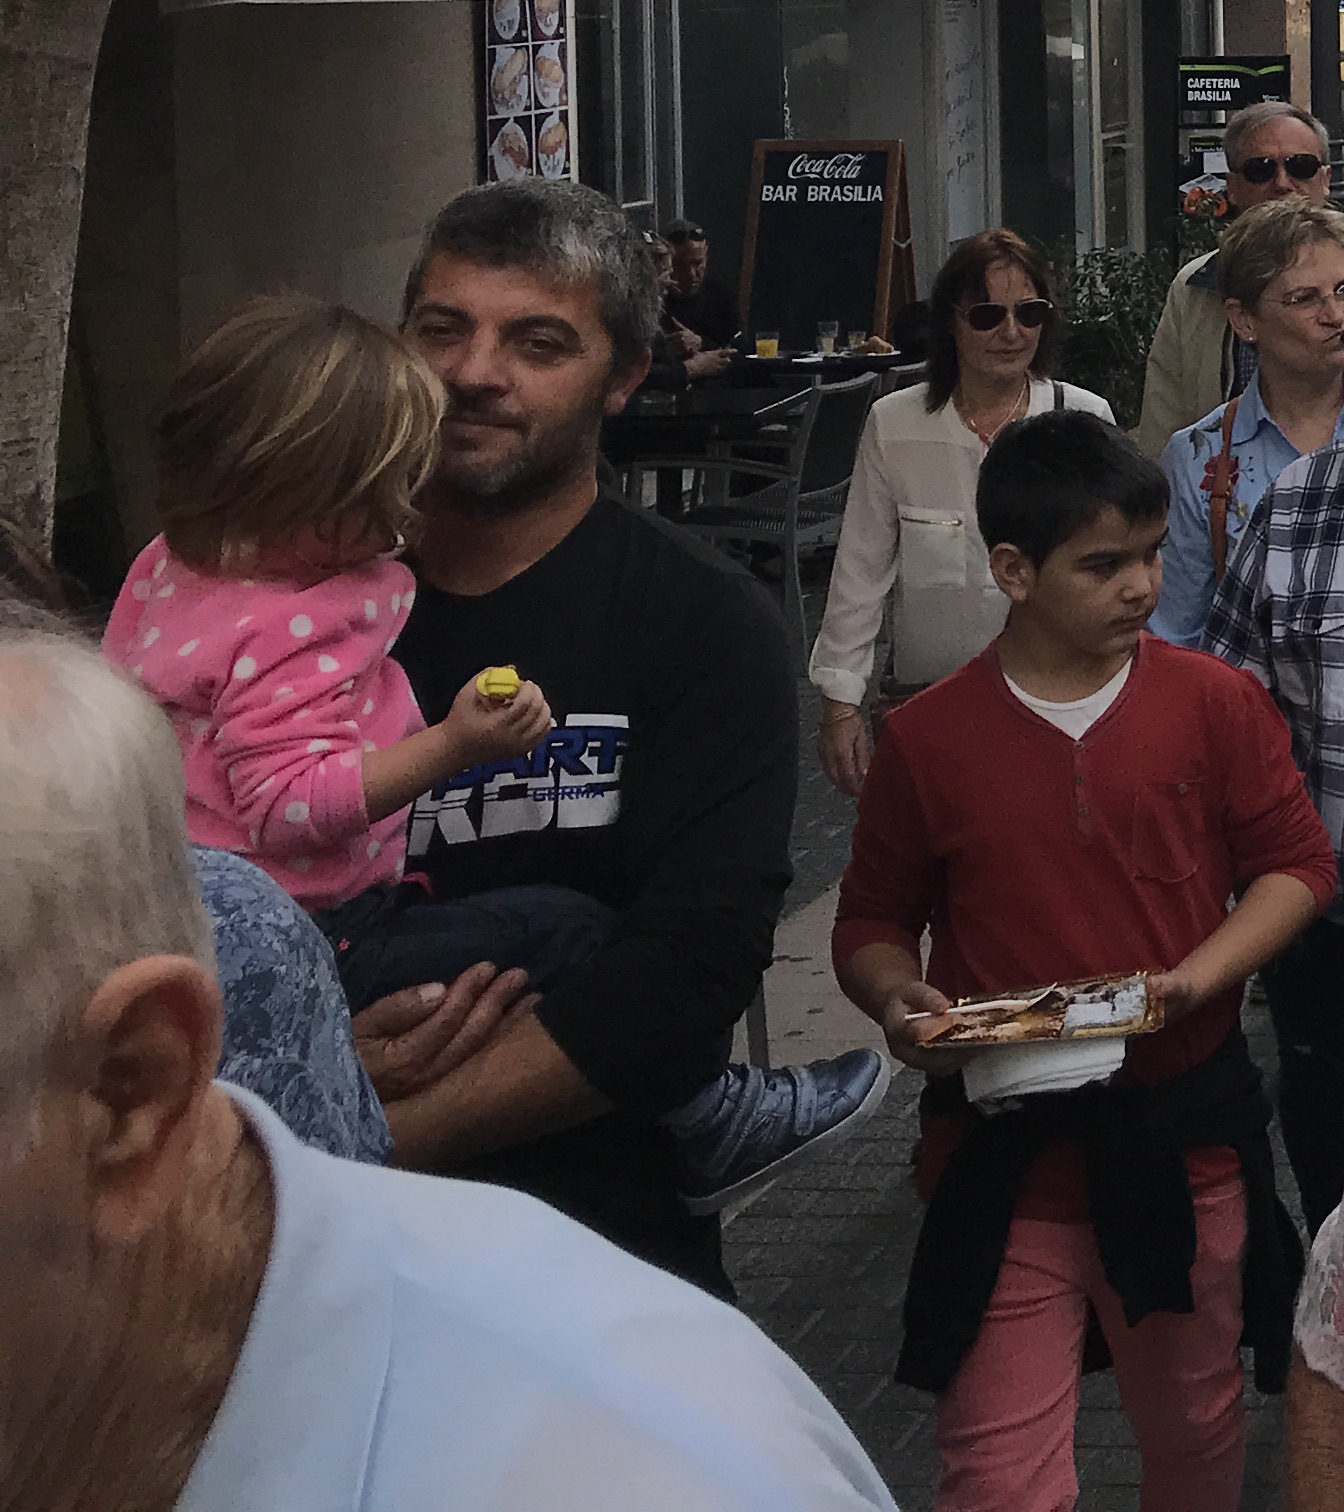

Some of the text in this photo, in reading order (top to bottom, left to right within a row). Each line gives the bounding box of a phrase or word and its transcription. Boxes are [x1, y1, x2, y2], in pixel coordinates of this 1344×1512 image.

[1187, 77, 1240, 89] CAFETERIA
[1187, 90, 1232, 102] BRASILIA
[761, 184, 883, 202] BAR BRASILIA
